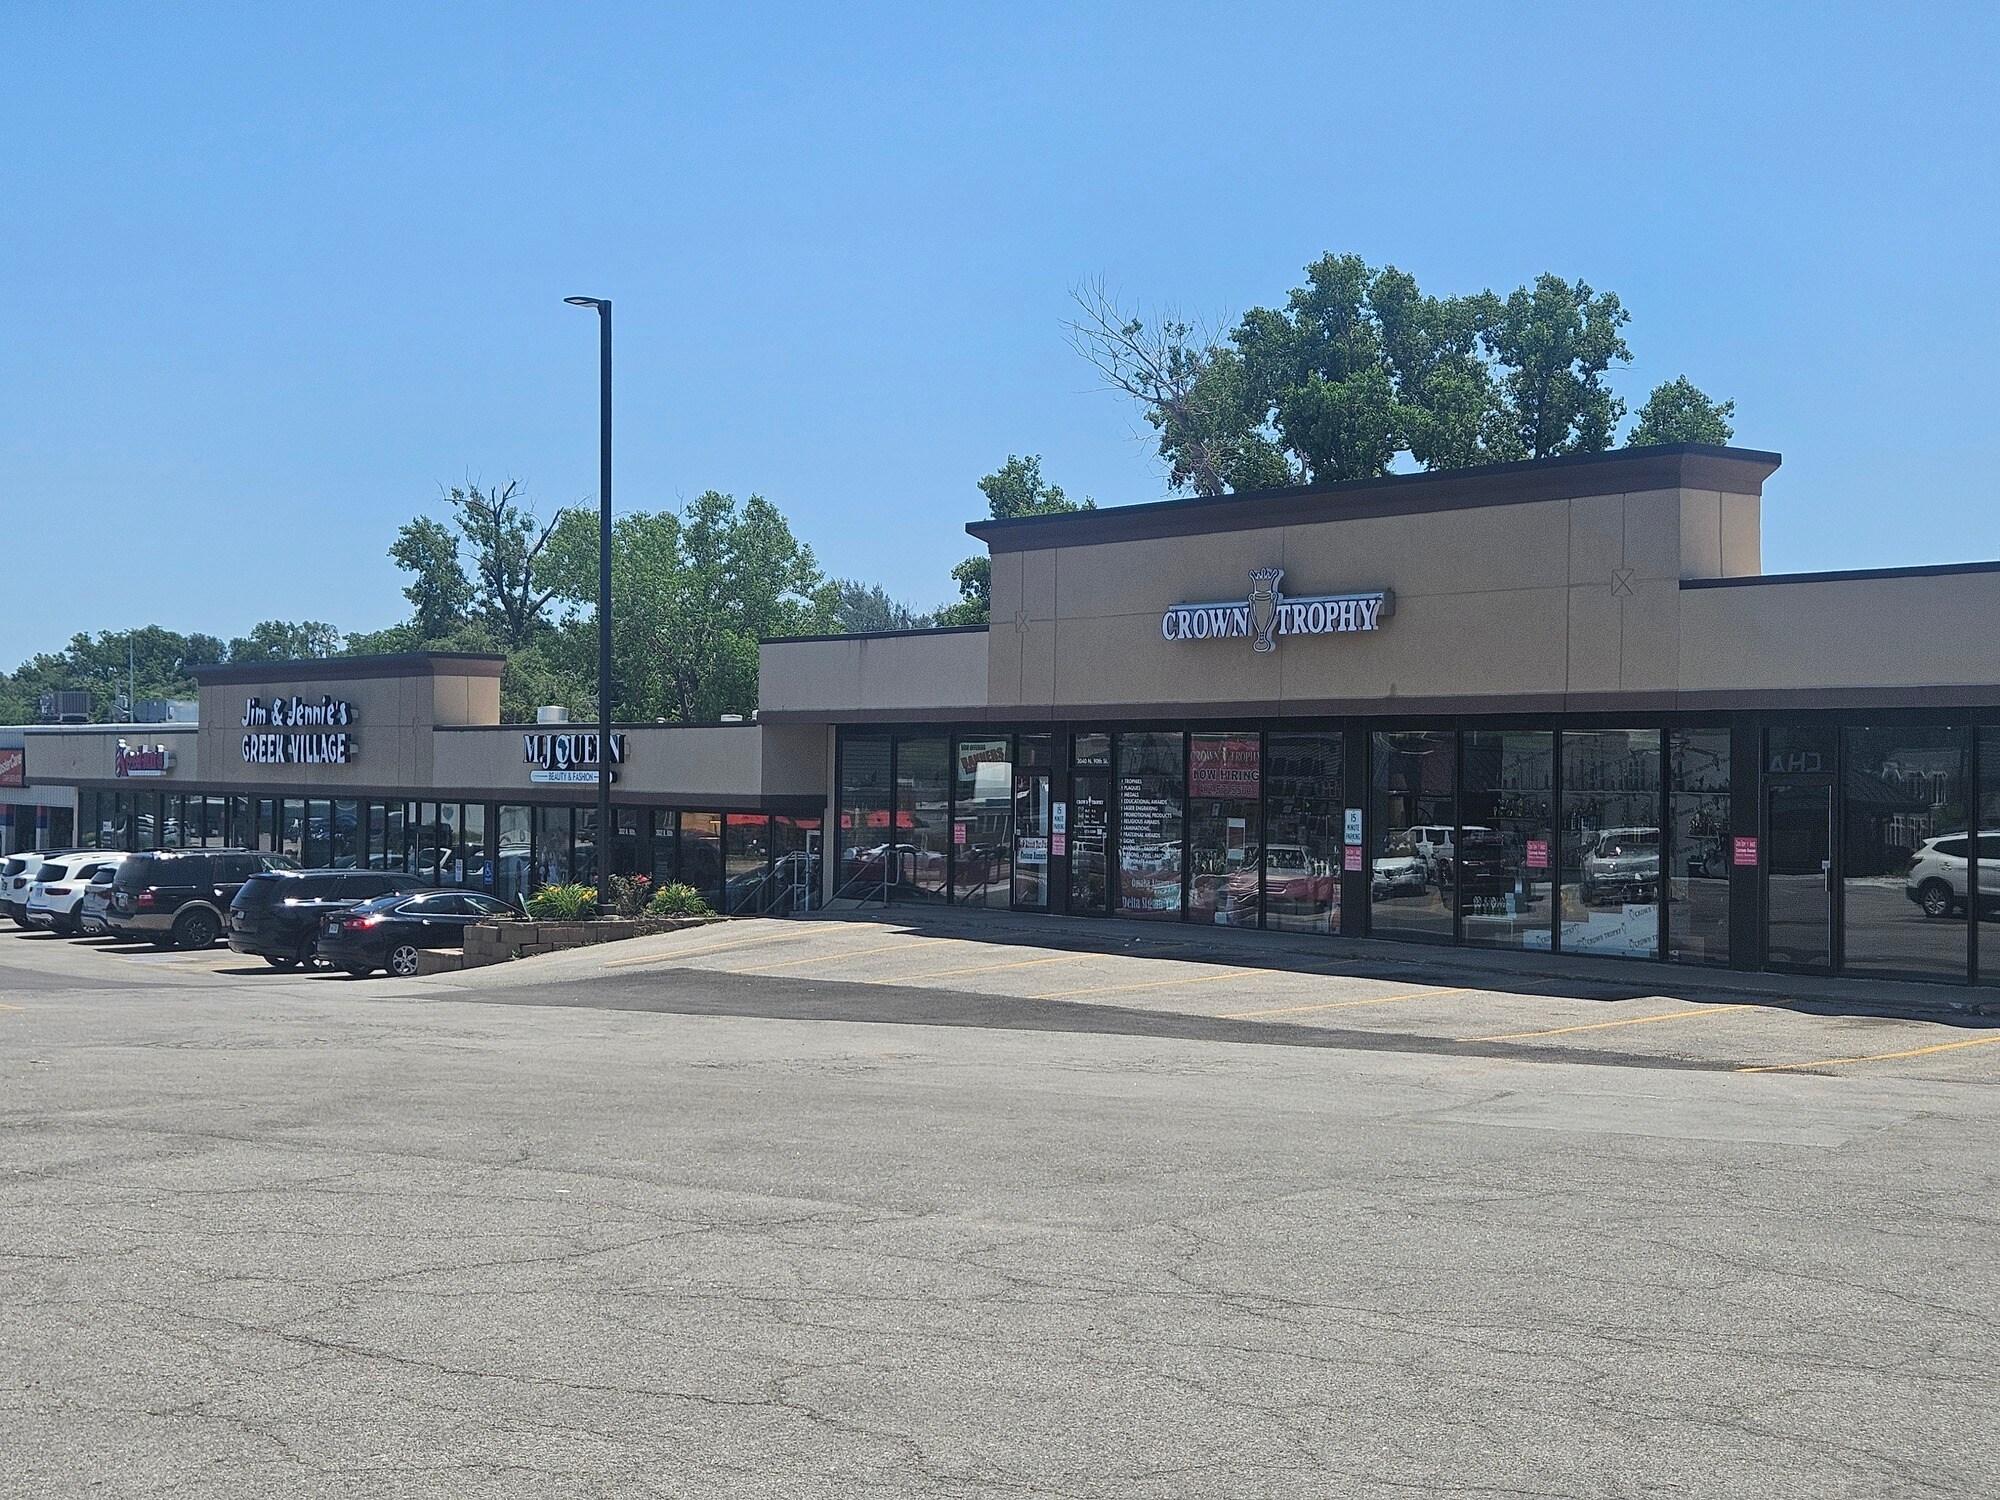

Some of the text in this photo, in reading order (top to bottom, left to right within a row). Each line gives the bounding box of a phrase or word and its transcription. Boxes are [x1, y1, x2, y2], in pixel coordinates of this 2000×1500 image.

[1162, 600, 1382, 640] CROWN TROPHY
[241, 695, 348, 727] Jim & Jennie's
[241, 733, 346, 763] GREEK VILLAGE
[548, 771, 567, 782] BEAUTY
[572, 771, 594, 782] FASHION
[1193, 768, 1260, 782] NOW HIRING
[1350, 813, 1356, 823] 15
[1347, 823, 1360, 831] MINUTE
